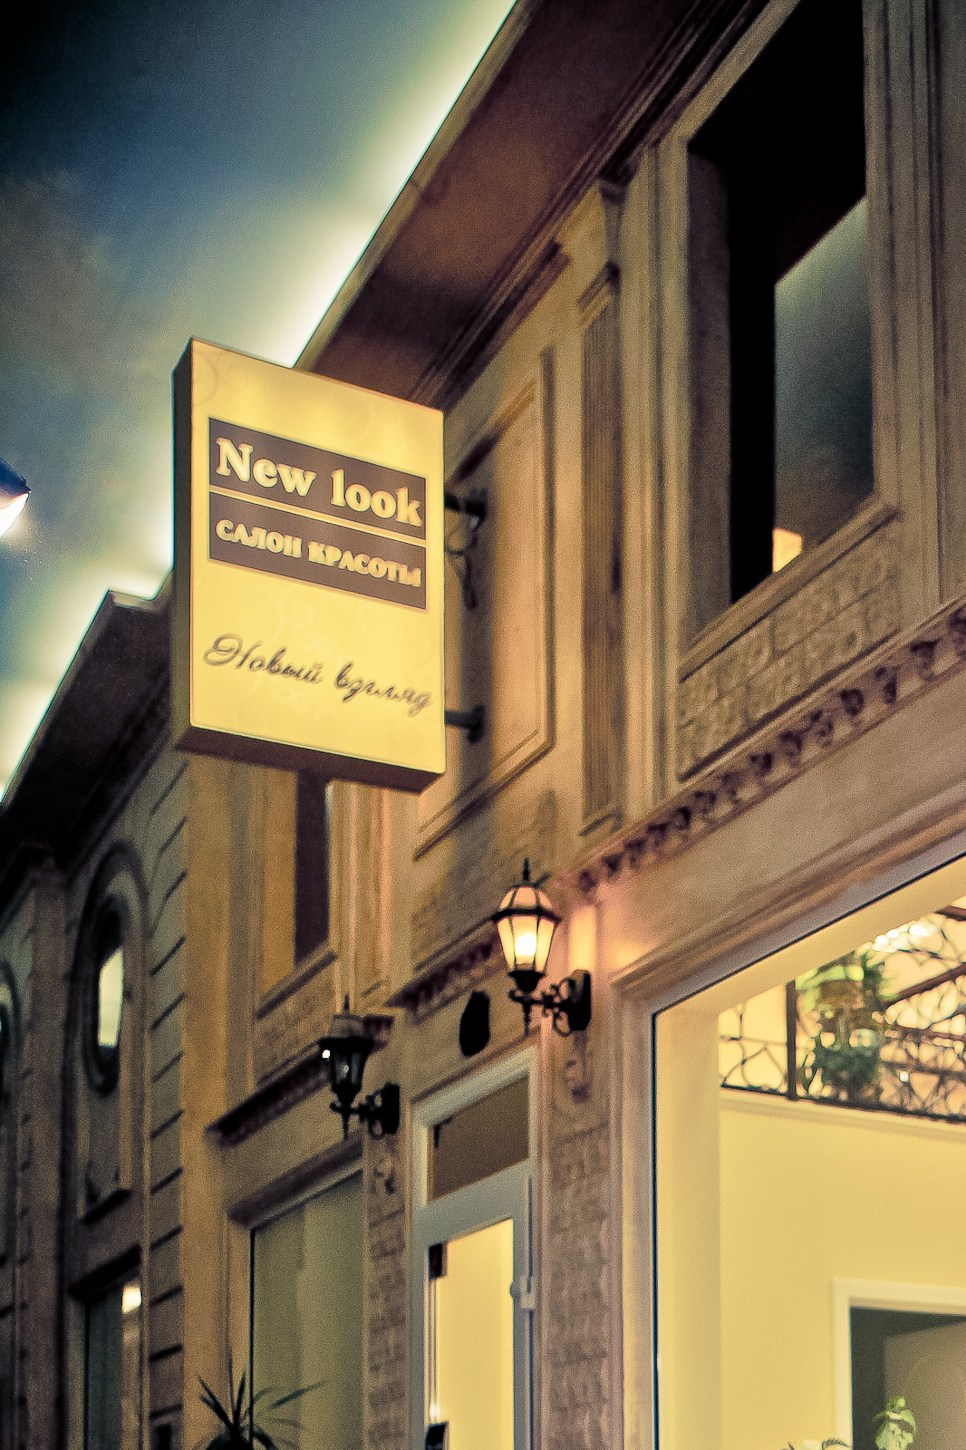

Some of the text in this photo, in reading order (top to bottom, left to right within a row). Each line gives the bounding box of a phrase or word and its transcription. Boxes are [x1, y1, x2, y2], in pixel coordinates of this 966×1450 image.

[216, 437, 424, 527] New look
[216, 519, 422, 587] САЛОН КРАСОТЫ
[203, 633, 432, 717] Новый взгляд
